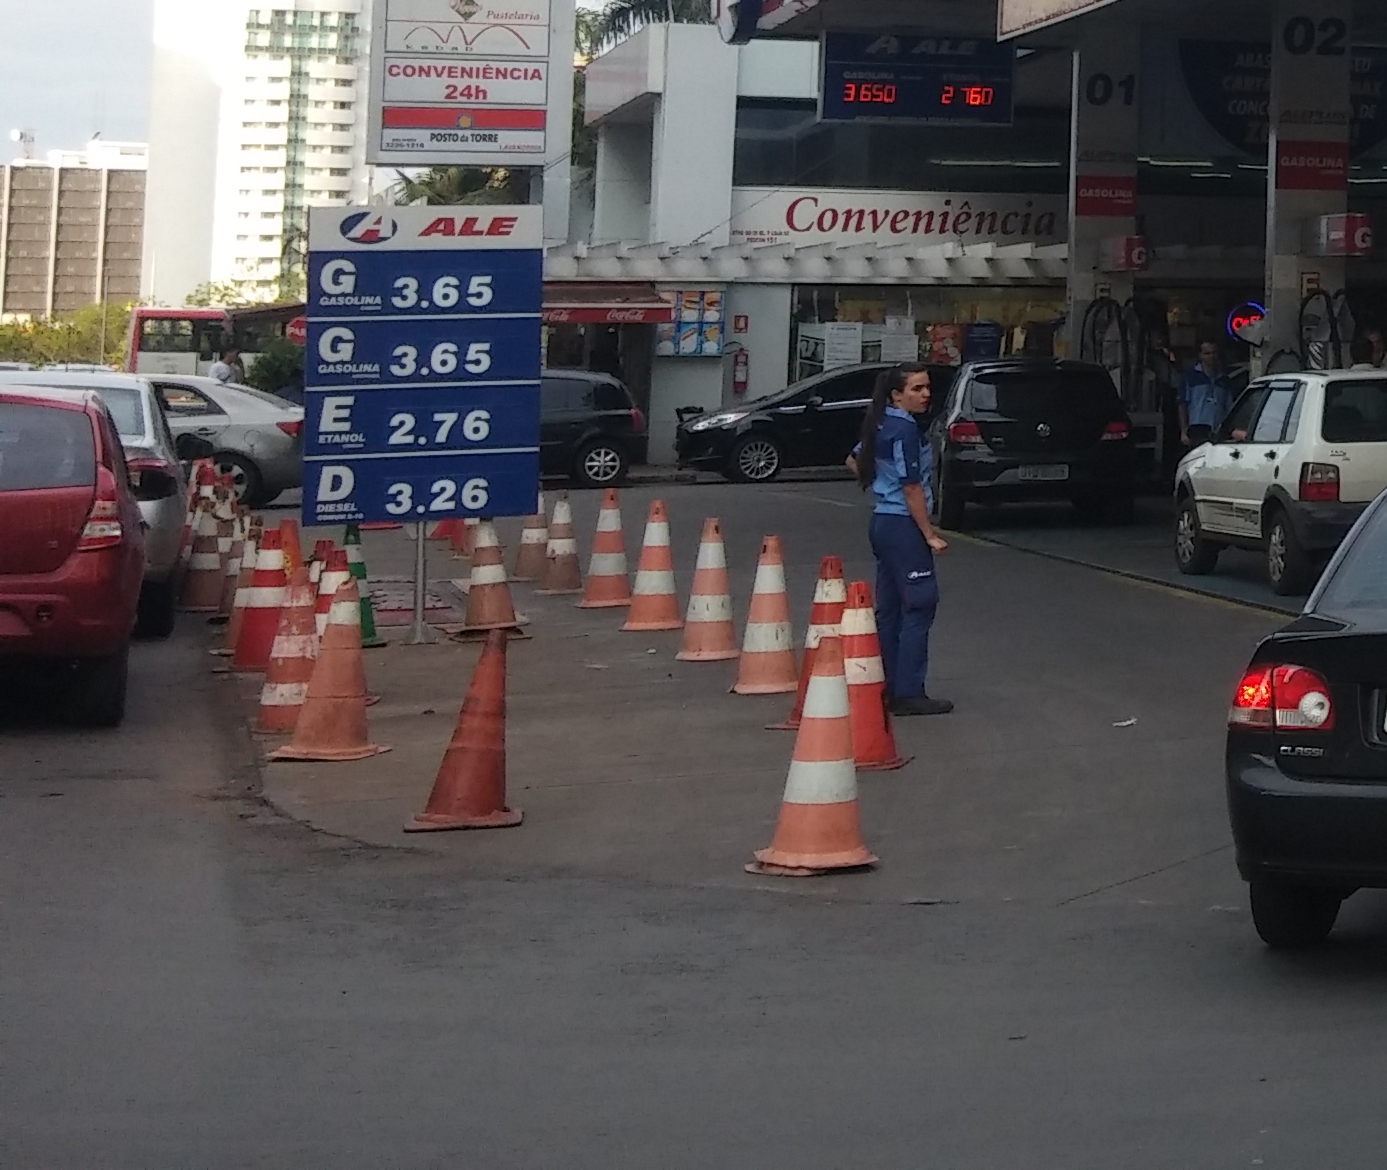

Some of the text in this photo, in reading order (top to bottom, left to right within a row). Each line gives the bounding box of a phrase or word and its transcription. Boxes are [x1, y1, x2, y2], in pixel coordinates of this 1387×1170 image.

[486, 10, 540, 21] Pastelaria
[1283, 16, 1347, 56] 02
[911, 39, 979, 56] ALE
[387, 64, 543, 80] CONVENIÊNCIA
[444, 84, 488, 100] 24h
[1085, 73, 1136, 105] 01
[430, 133, 498, 143] POSTO da TORRE
[1281, 155, 1343, 170] GASOLINA
[1079, 187, 1133, 199] GASOLINA
[786, 197, 1056, 237] Conveniência
[418, 217, 519, 237] ALE
[1354, 228, 1371, 248] G
[1131, 246, 1147, 264] G
[320, 259, 356, 295] G
[320, 296, 382, 305] GASOLINA
[390, 275, 493, 308] 3.65
[607, 309, 645, 320] Coca-Cola
[318, 327, 355, 362] G
[318, 364, 380, 374] GASOLINA
[389, 343, 491, 376] 3.65
[319, 396, 355, 432] E
[388, 410, 491, 445] 2.76
[318, 433, 366, 443] ETANOL
[316, 466, 354, 502] D
[385, 478, 489, 515] 3.26
[316, 503, 358, 513] DIESEL
